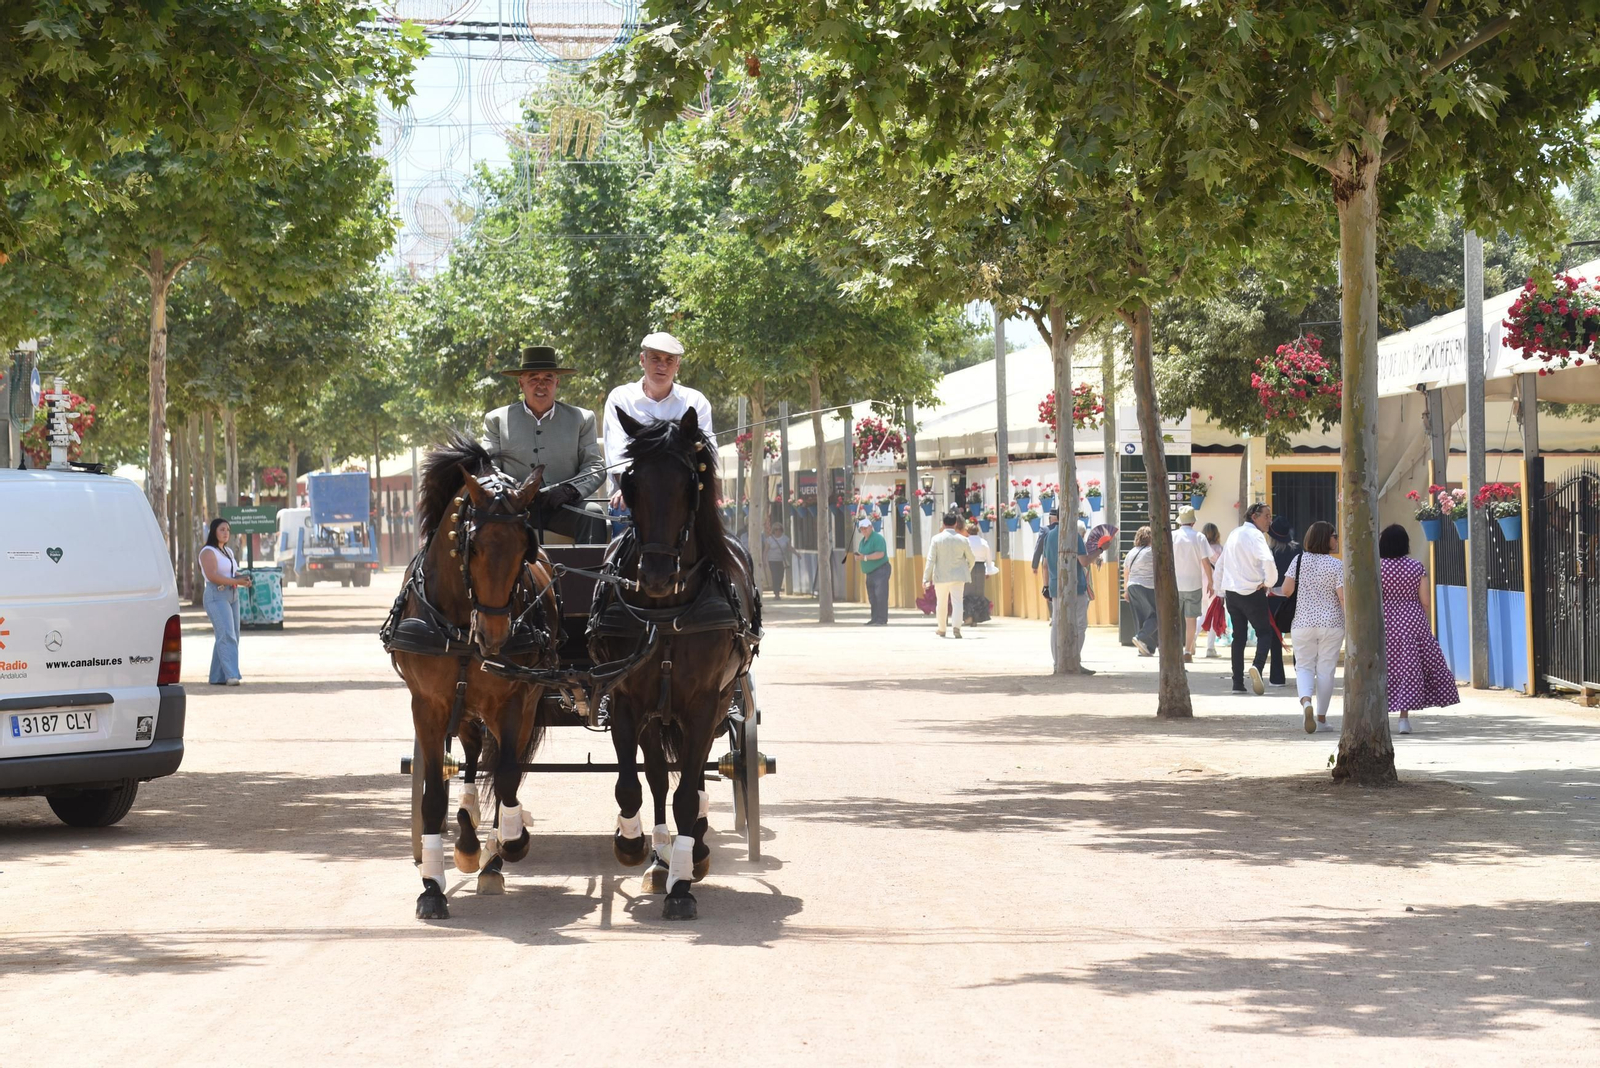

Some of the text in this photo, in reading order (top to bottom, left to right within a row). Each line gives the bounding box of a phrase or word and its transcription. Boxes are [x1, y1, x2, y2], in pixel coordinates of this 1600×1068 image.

[0, 660, 28, 671] Radio
[45, 657, 123, 669] www.canalsur.es
[22, 712, 93, 734] 3187 CLY
